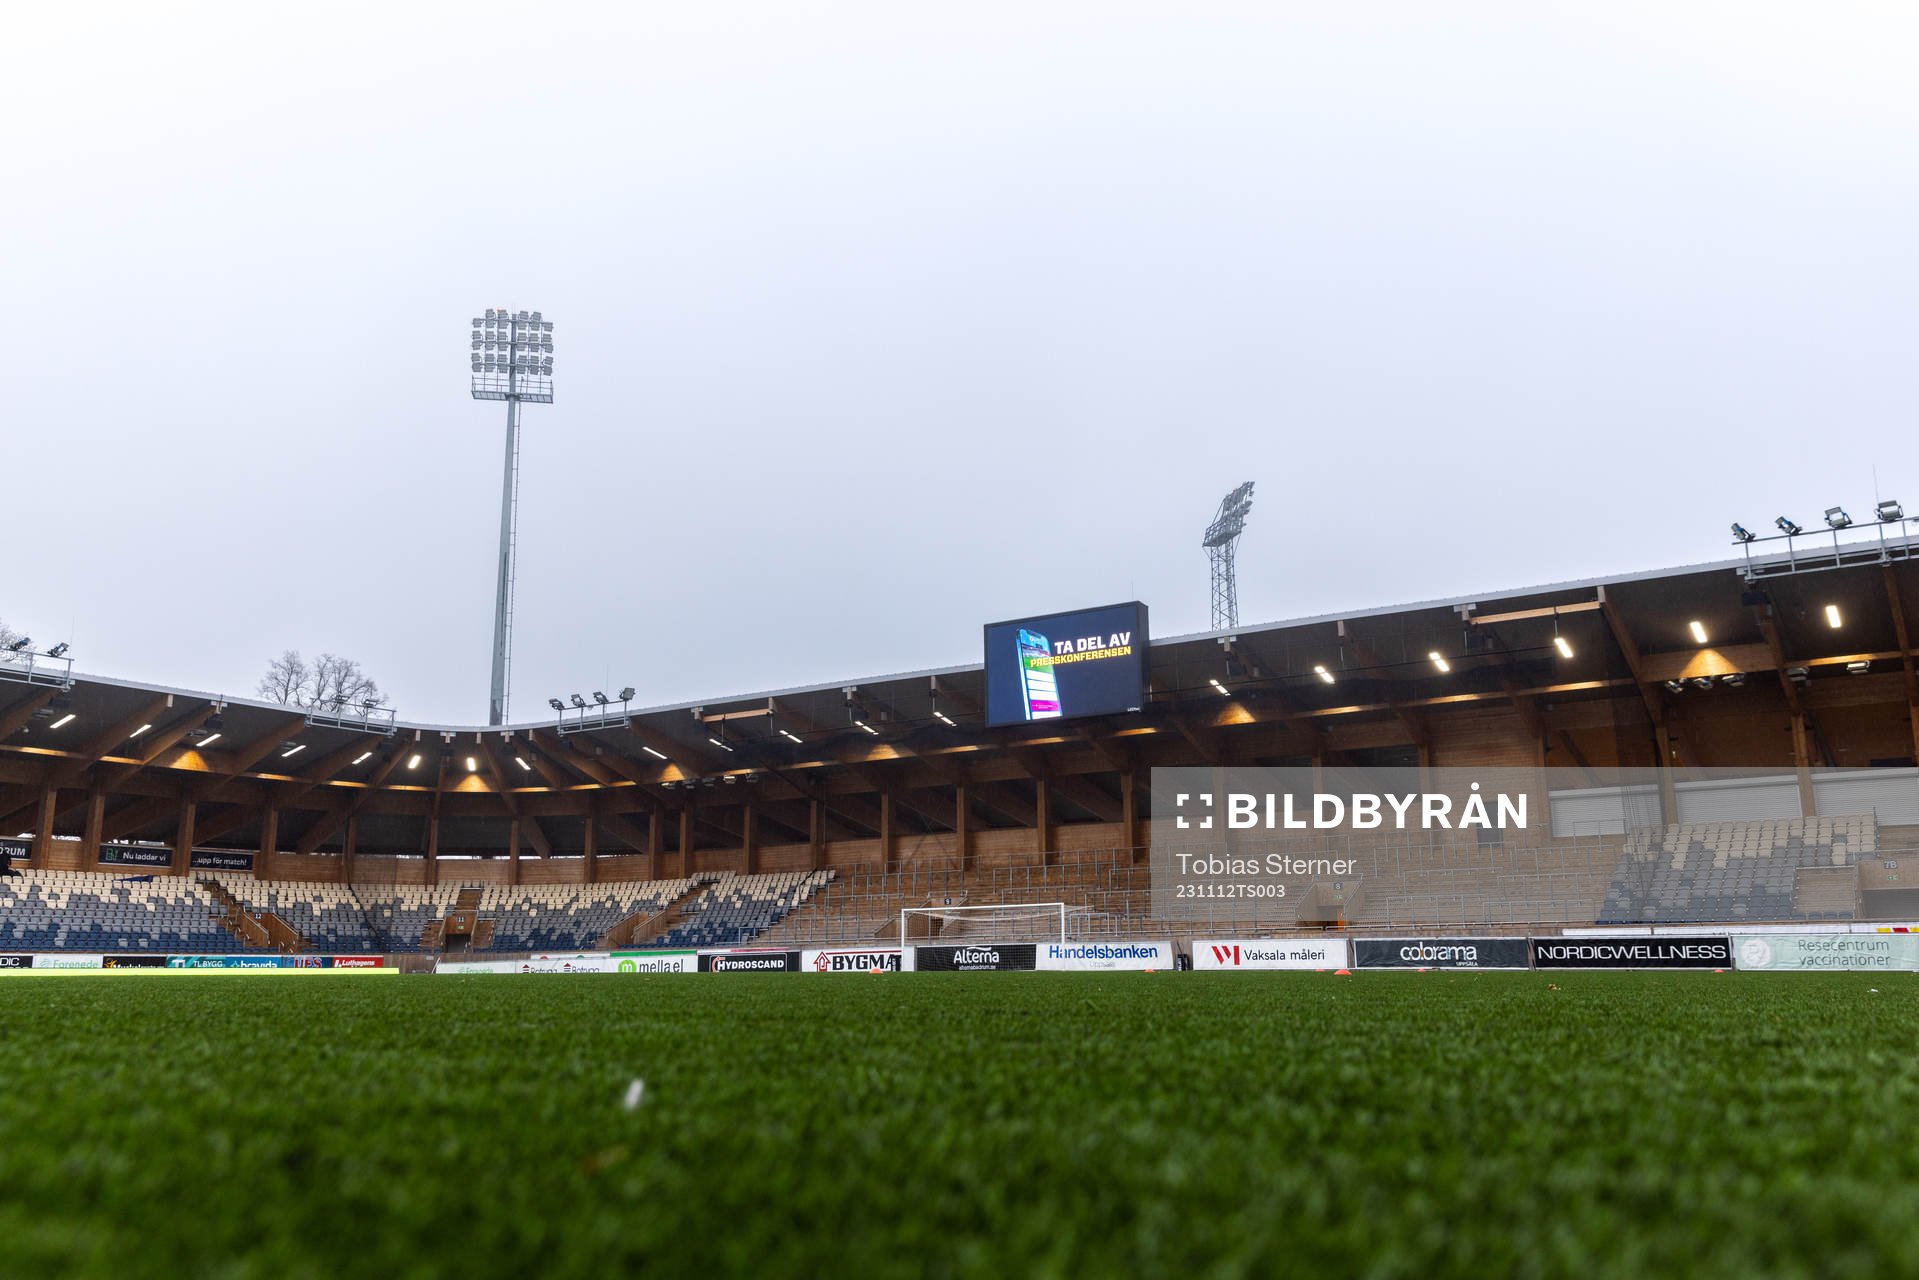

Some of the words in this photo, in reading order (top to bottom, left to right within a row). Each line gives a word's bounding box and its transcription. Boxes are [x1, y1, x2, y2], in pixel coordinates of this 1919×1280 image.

[1054, 641, 1073, 655] TA
[1077, 636, 1106, 653] DEL
[1108, 631, 1131, 647] AV
[1030, 646, 1132, 667] PRESSKONFERENSEN
[122, 852, 134, 860] Nu
[135, 852, 158, 861] laddar
[159, 854, 167, 862] vi
[212, 856, 223, 864] för
[223, 858, 247, 866] match!
[1883, 860, 1897, 869] 7B
[1400, 941, 1477, 961] colorama
[1799, 939, 1889, 951] Resecentrum
[953, 949, 1000, 964] Alterna
[1244, 949, 1286, 961] Vaksala
[1290, 948, 1325, 961] måleri
[1799, 954, 1891, 966] vaccinationer
[639, 959, 671, 973] mella
[718, 959, 785, 971] HYDROSCAND
